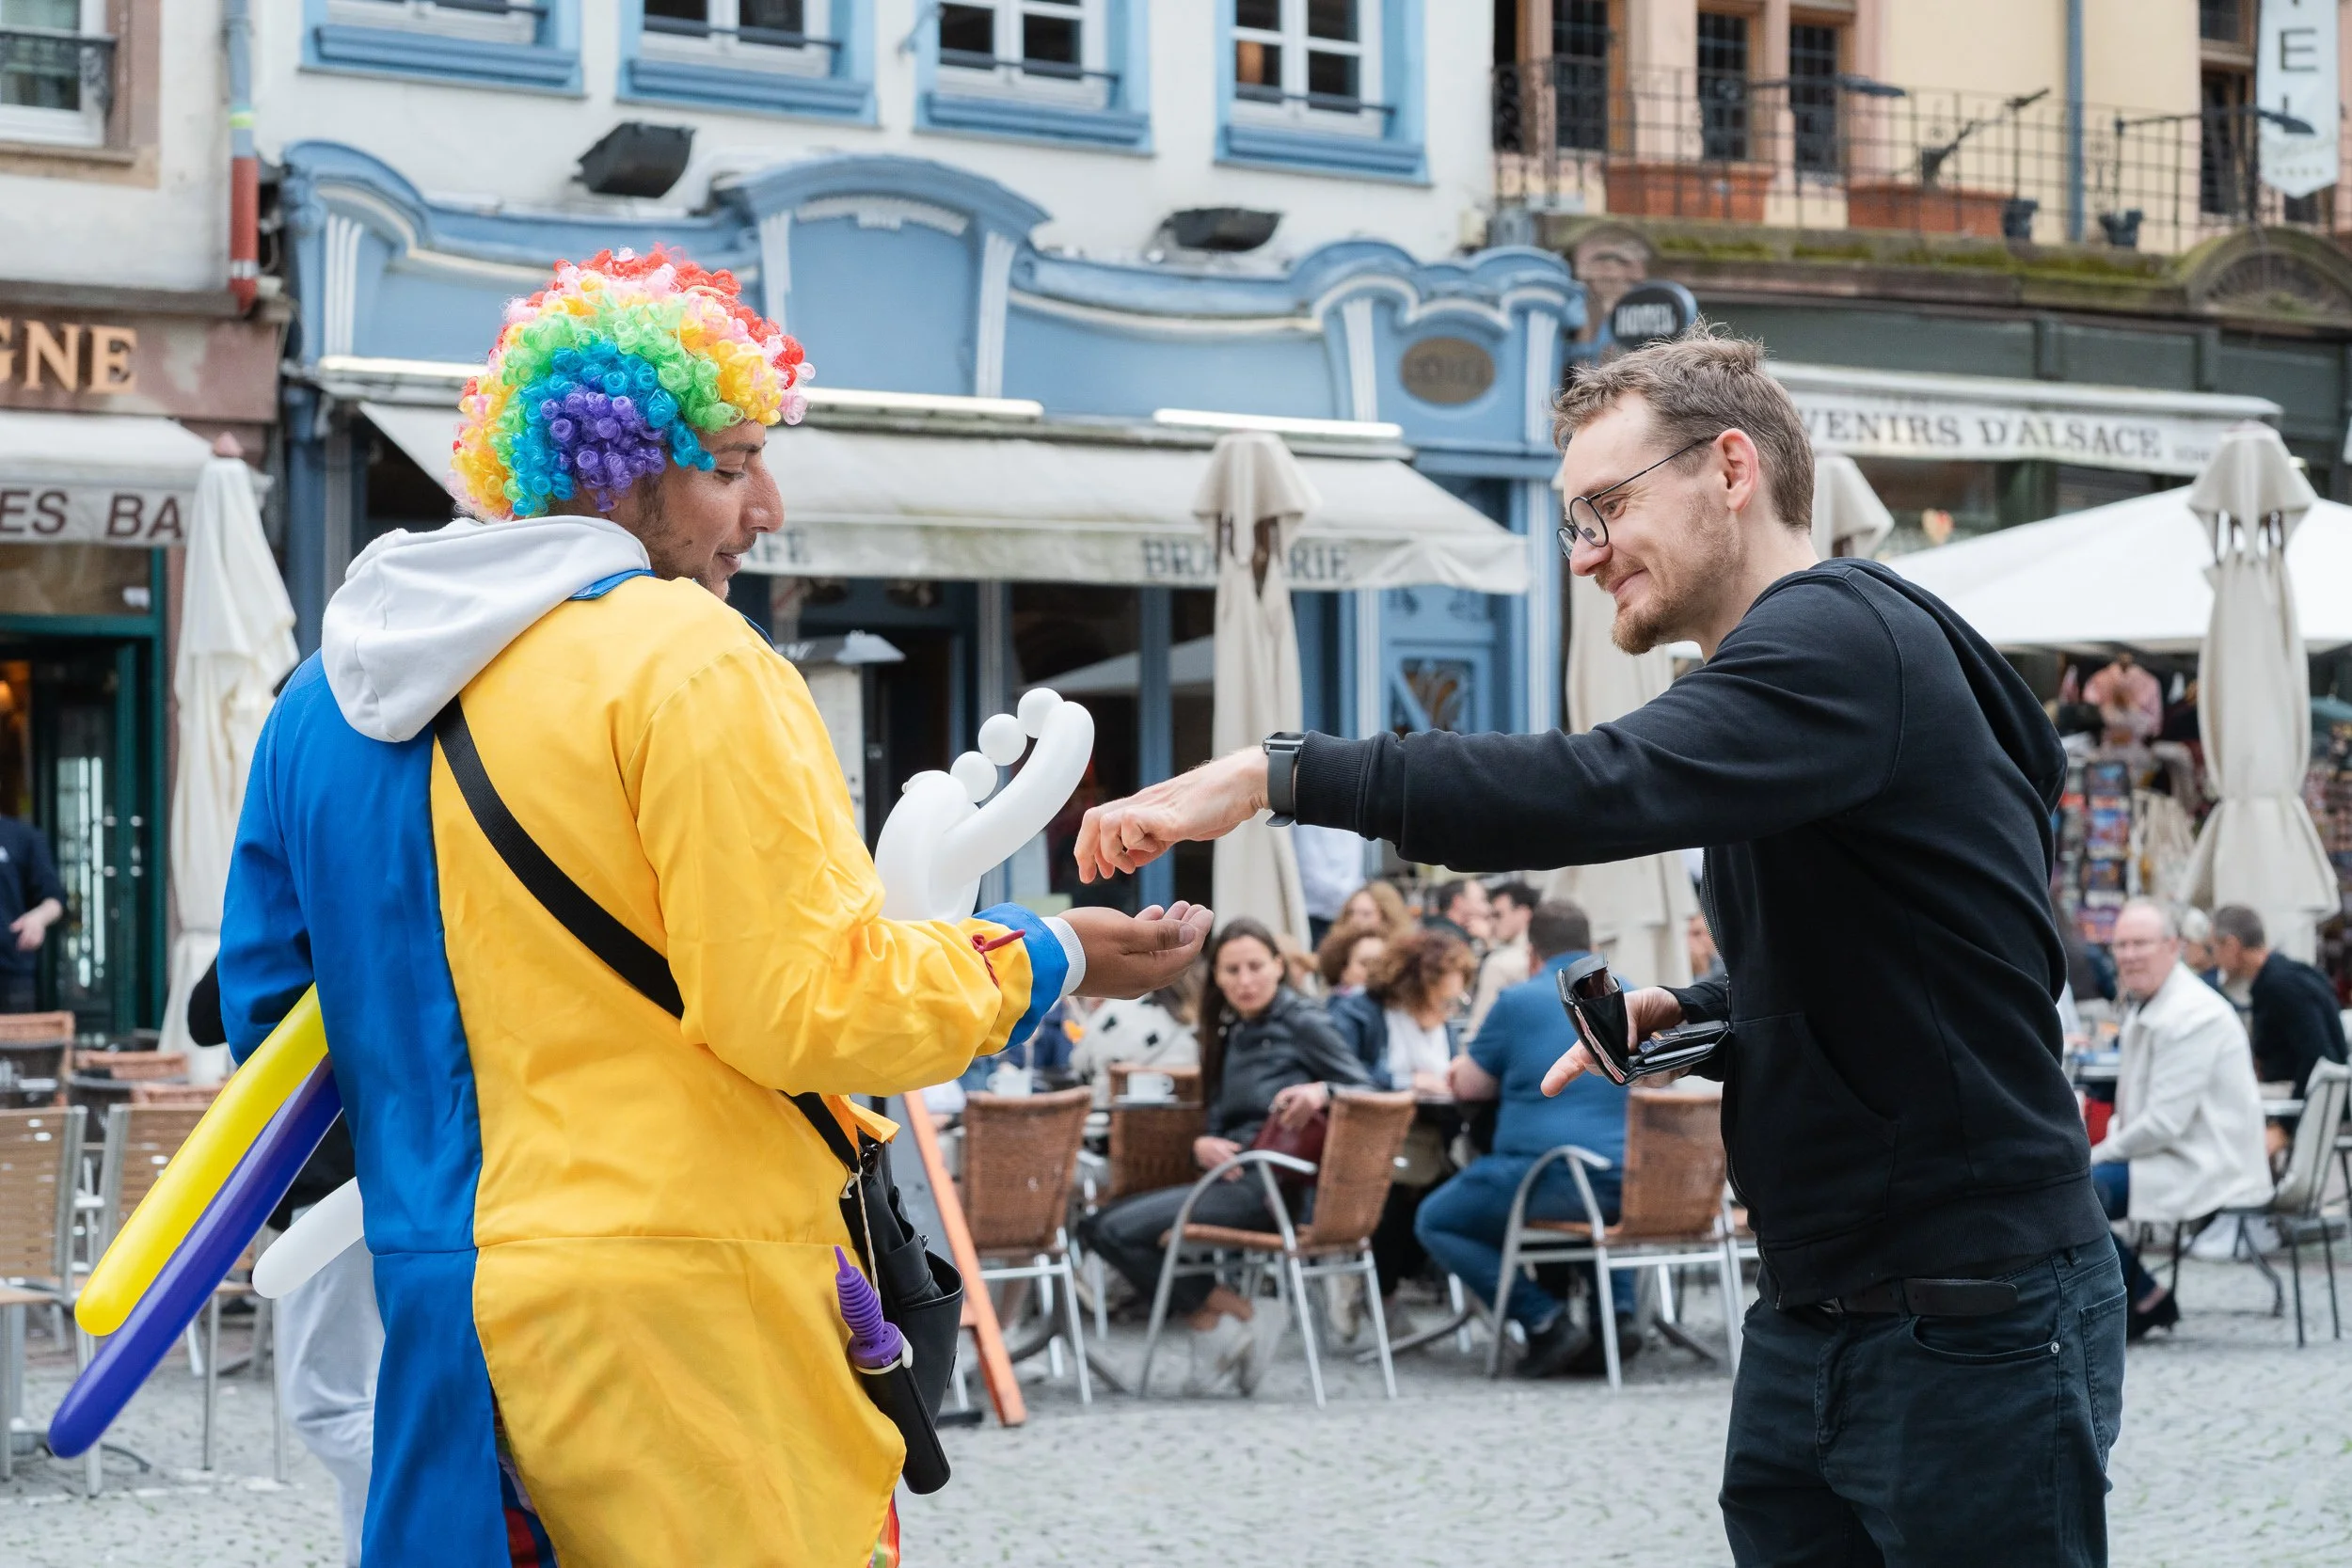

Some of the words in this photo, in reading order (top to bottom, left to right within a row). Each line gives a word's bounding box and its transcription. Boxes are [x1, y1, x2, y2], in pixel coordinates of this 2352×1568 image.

[1979, 414, 2163, 459] D'ALSACE
[0, 488, 68, 536] ES
[104, 492, 183, 540] BA
